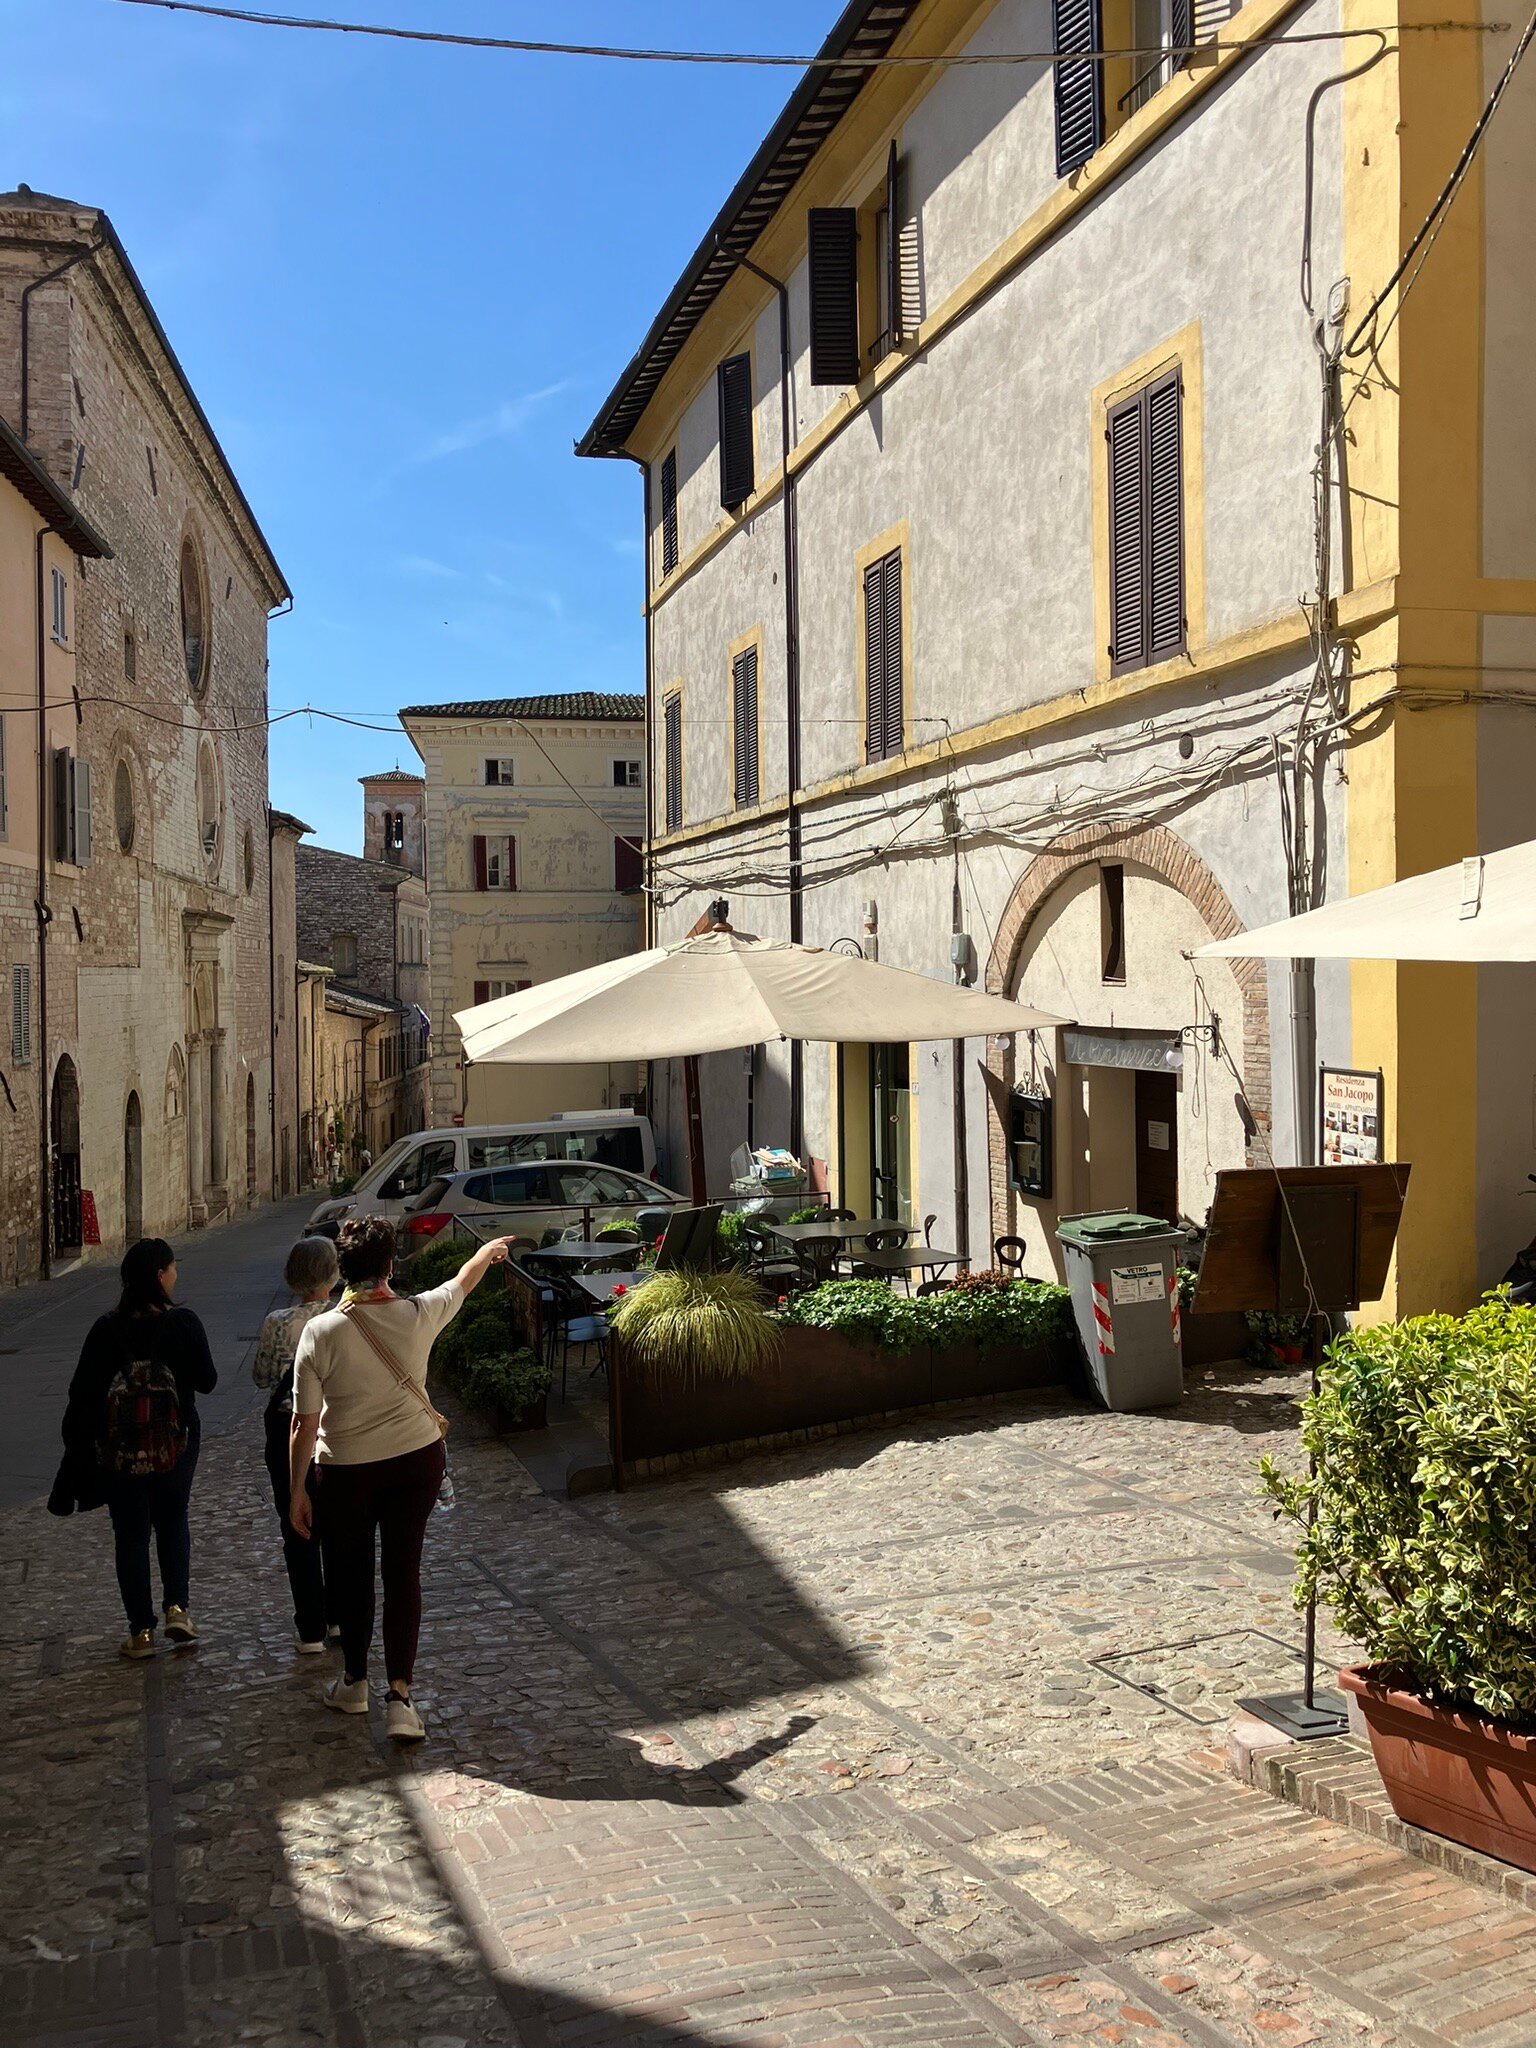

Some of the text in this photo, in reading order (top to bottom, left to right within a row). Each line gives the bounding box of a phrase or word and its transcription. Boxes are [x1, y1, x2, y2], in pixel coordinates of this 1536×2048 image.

[1336, 1075, 1365, 1086] Residenza
[1328, 1084, 1374, 1103] San Jacopo
[1126, 1266, 1148, 1274] VETRO
